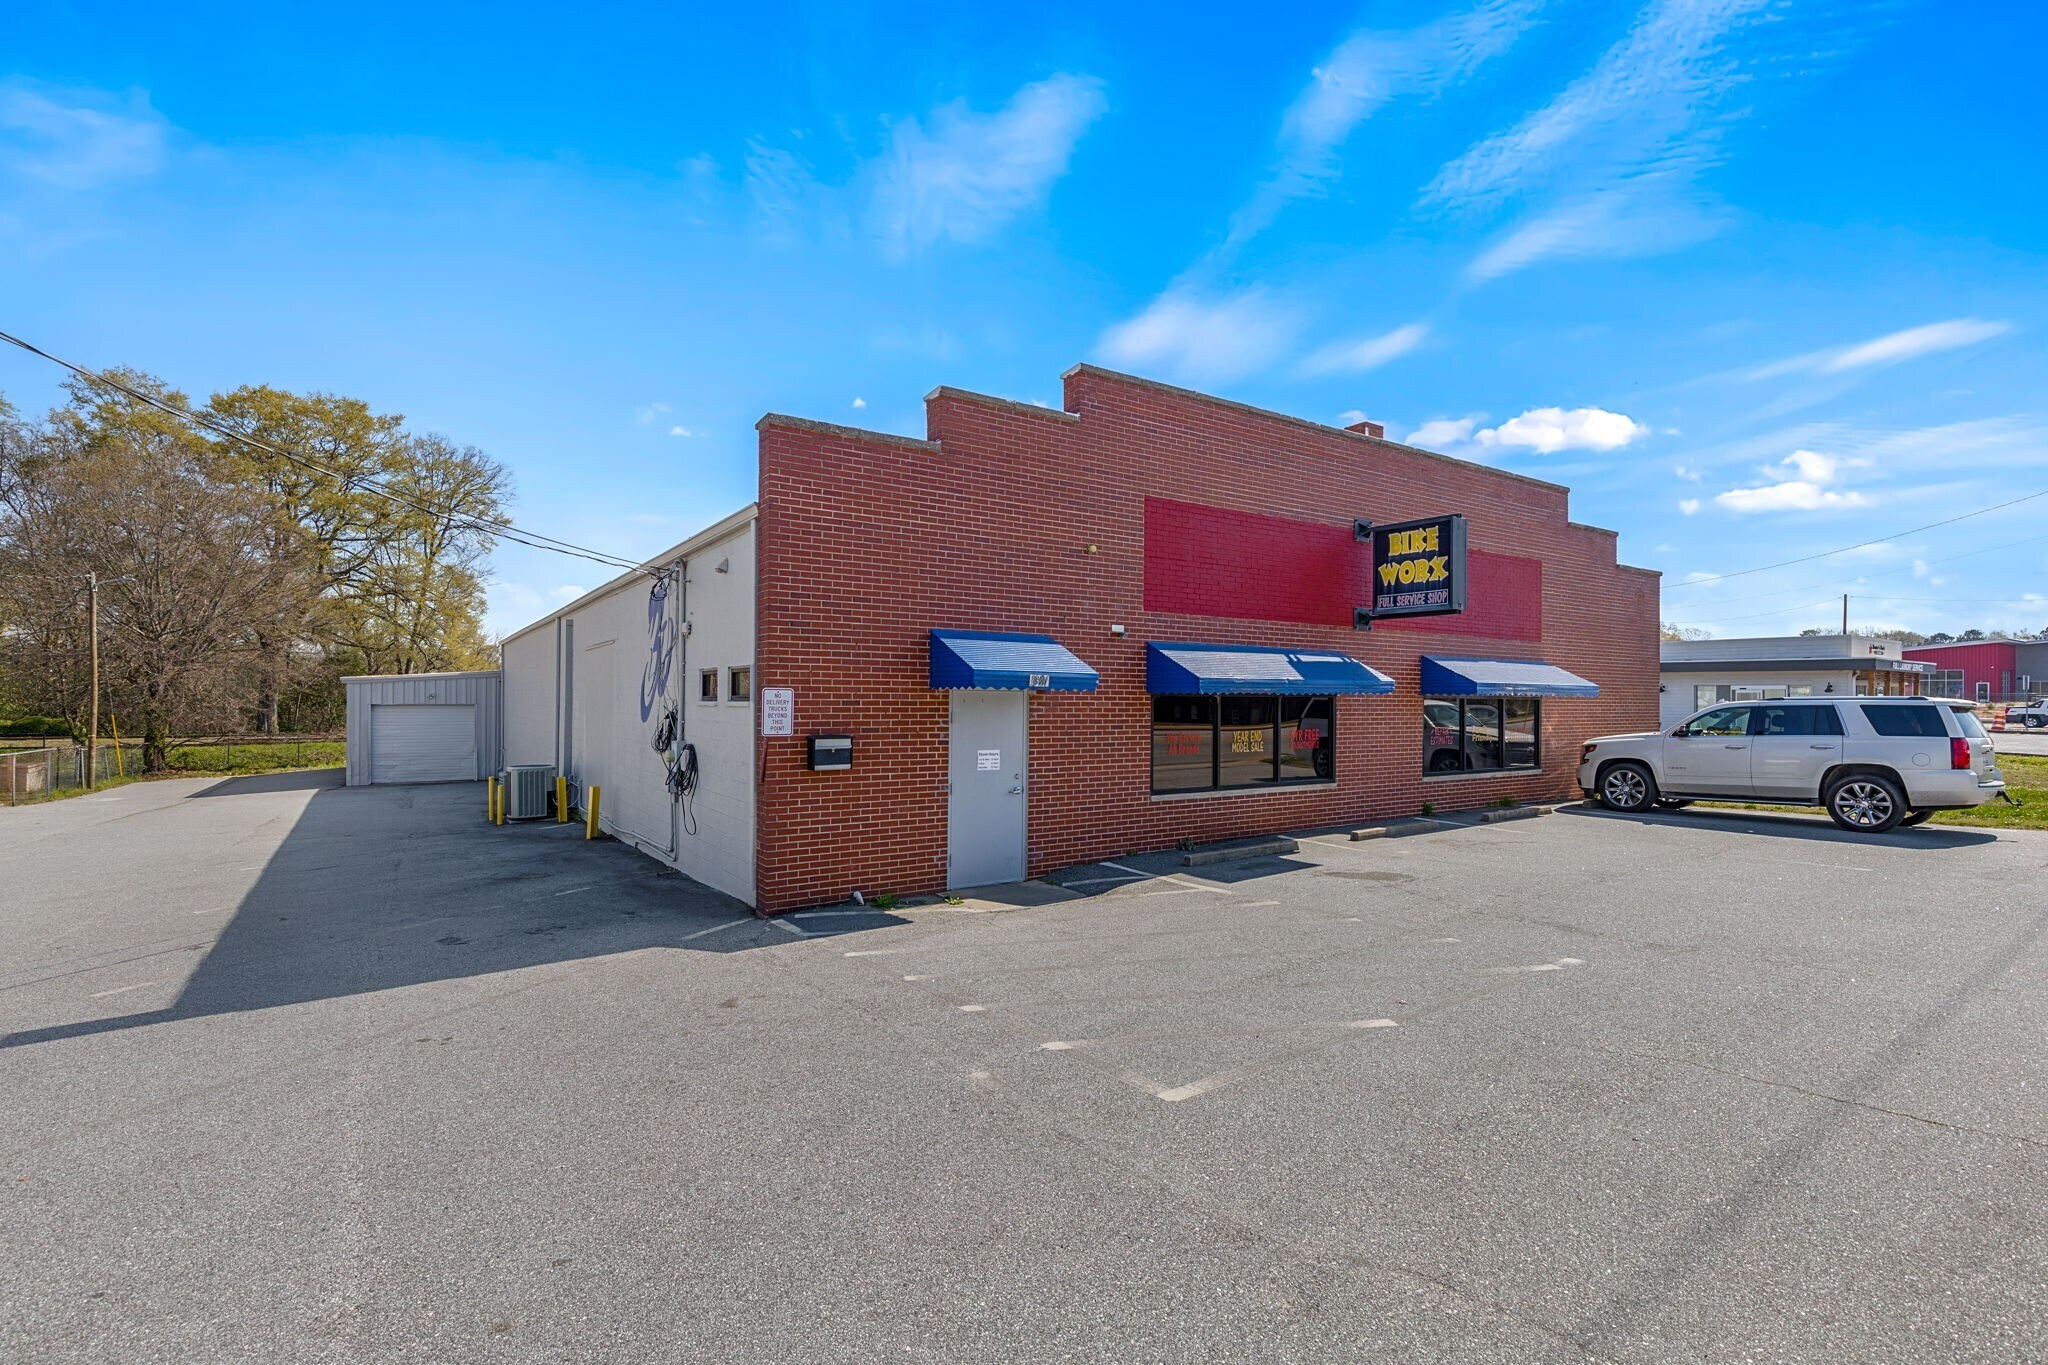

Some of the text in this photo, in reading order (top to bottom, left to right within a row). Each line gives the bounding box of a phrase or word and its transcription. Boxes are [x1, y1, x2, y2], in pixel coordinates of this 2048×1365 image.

[1388, 525, 1439, 556] BIKE
[1378, 556, 1449, 586] WORX
[1379, 591, 1447, 608] FULL SERVICE SHOP
[1233, 730, 1263, 742] YEAR END
[1304, 728, 1320, 741] FREE
[1430, 735, 1454, 745] ESTIMATES
[1231, 741, 1250, 753] MODEL
